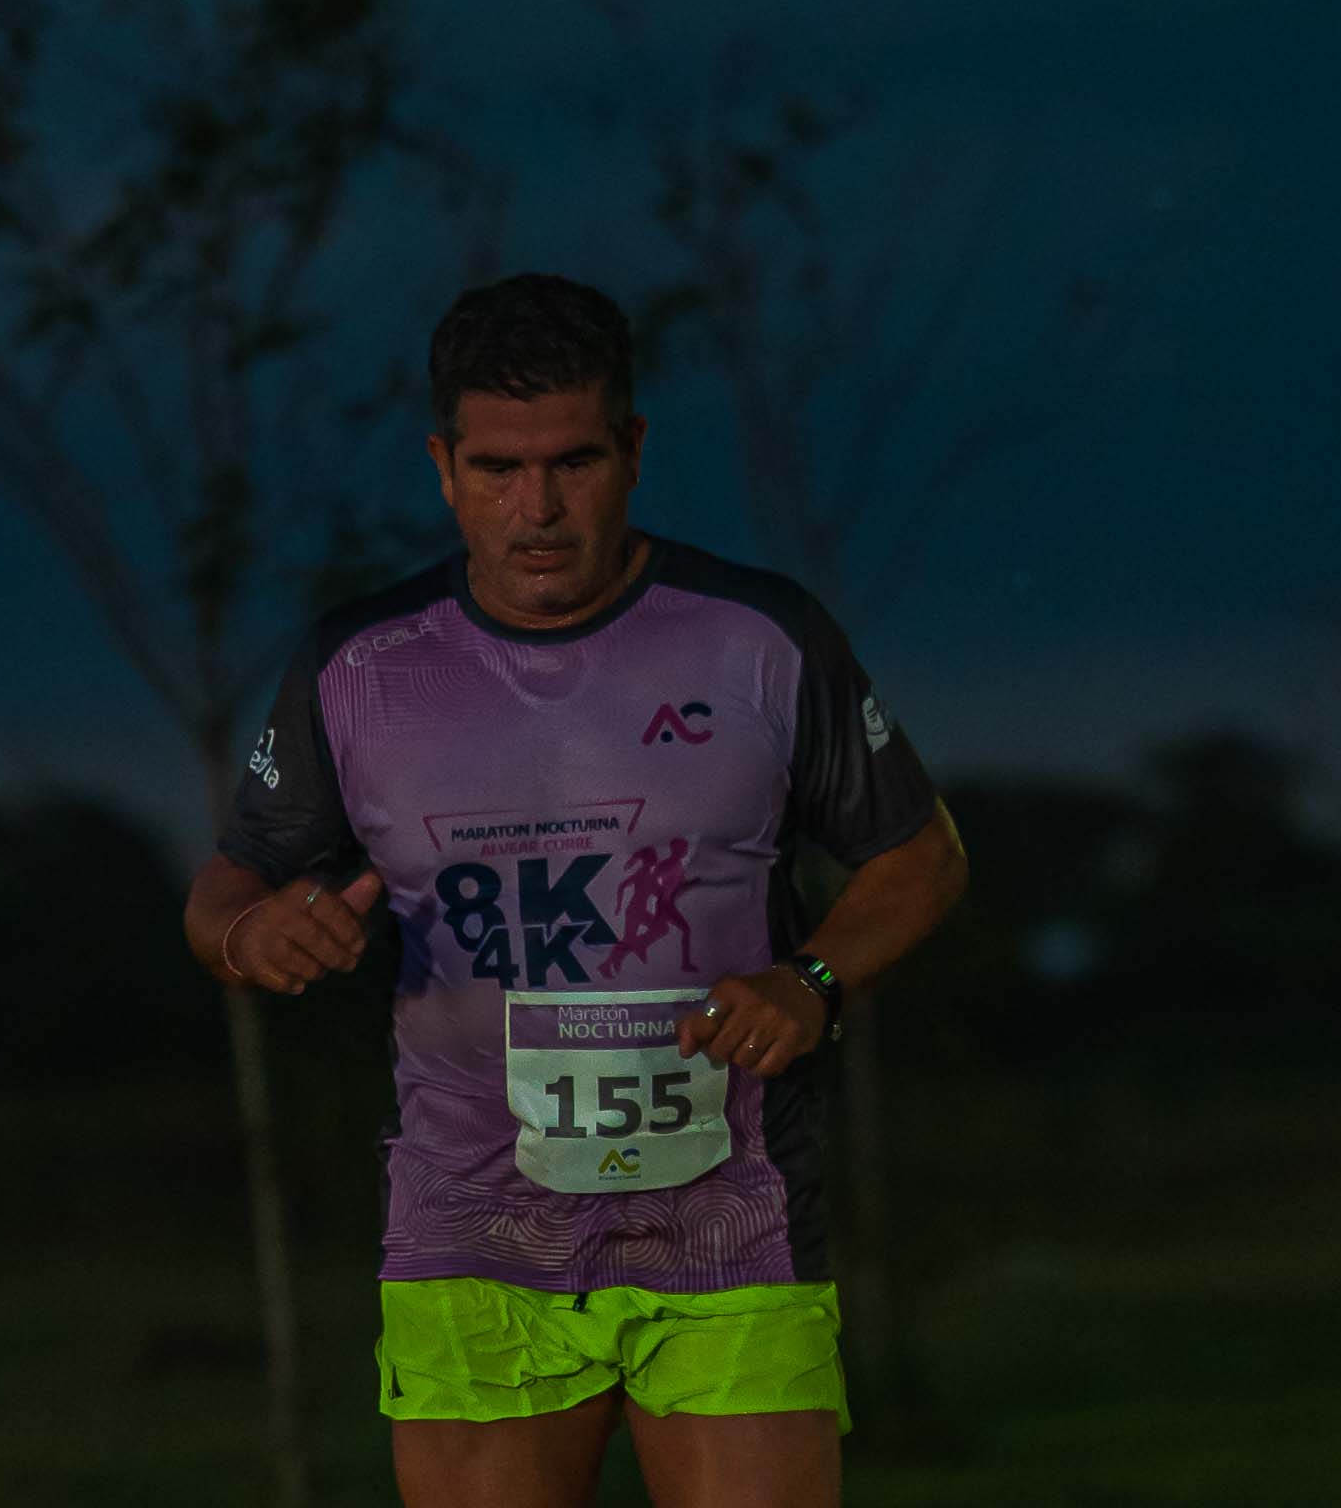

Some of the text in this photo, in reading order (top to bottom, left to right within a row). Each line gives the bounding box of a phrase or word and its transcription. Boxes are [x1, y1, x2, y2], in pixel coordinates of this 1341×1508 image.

[642, 702, 713, 745] AC
[451, 817, 620, 841] MARATON NOCTURNA
[480, 836, 595, 858] ALVEAR CORRE
[435, 854, 618, 953] 8K
[472, 924, 592, 990] 4K
[558, 1005, 629, 1022] Maratón
[558, 1020, 676, 1040] NOCTURNA
[545, 1070, 693, 1139] 155
